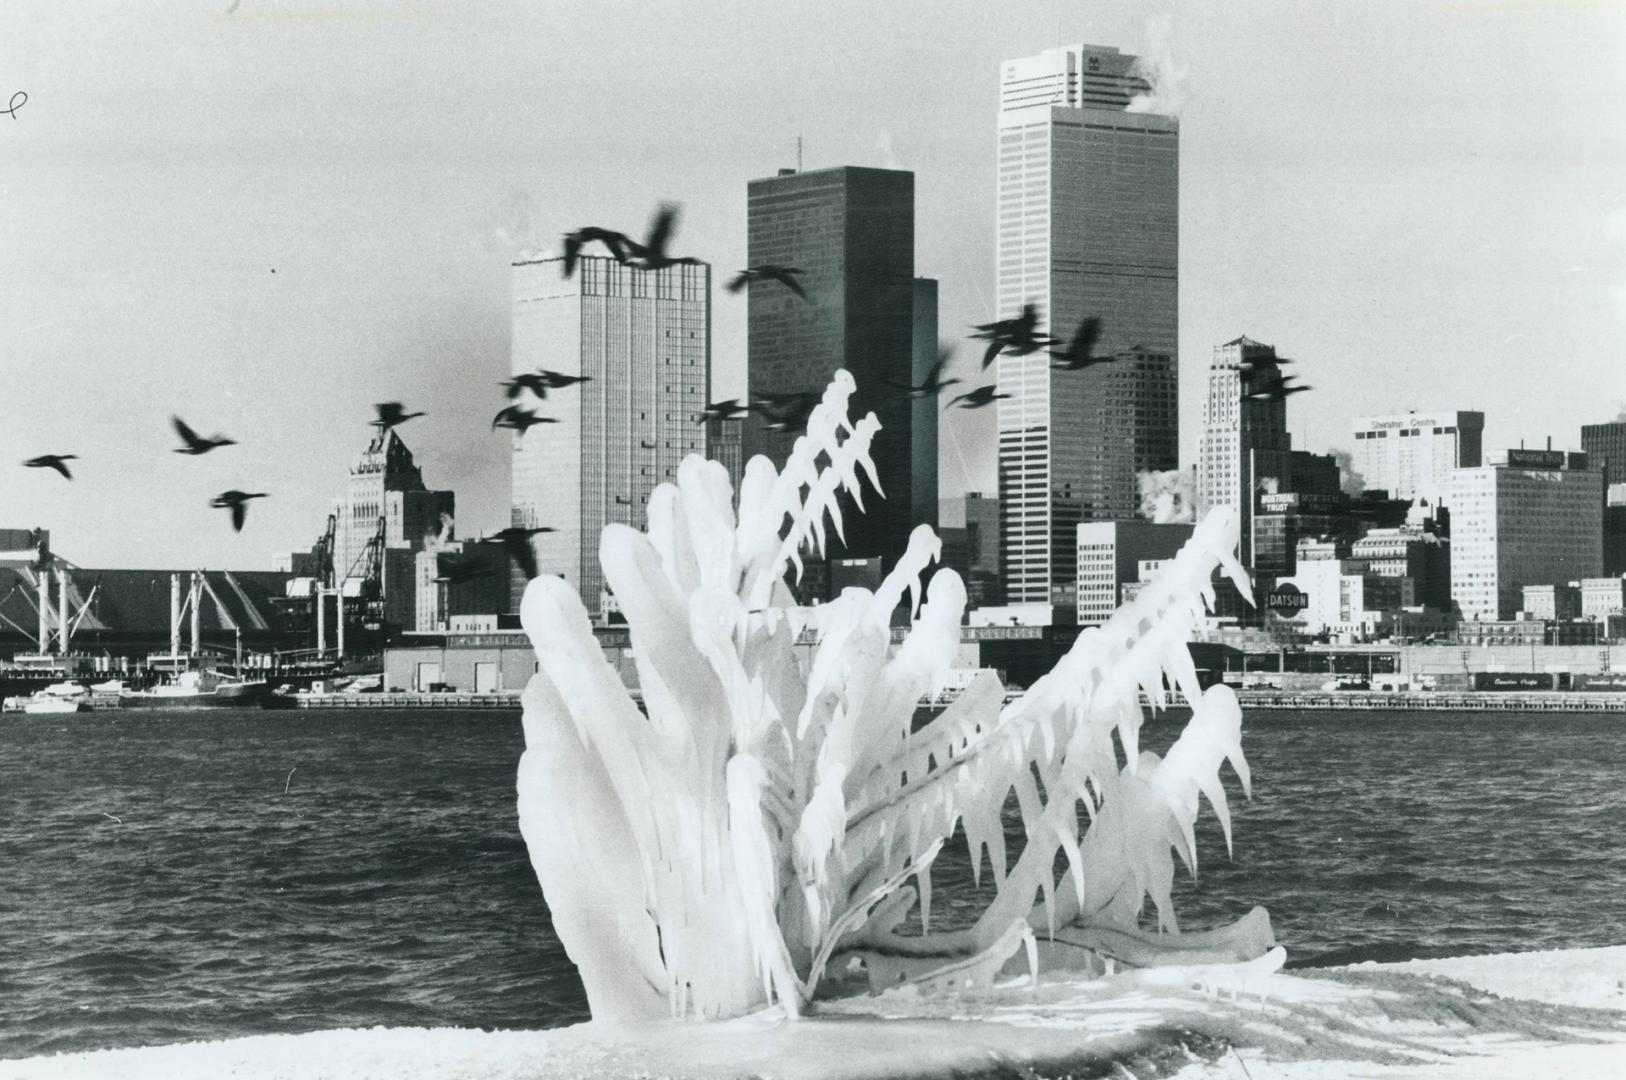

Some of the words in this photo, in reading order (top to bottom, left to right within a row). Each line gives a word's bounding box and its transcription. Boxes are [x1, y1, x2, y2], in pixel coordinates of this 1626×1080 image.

[1261, 493, 1295, 504] MONTREAL
[1267, 503, 1288, 512] TRUST
[1270, 595, 1306, 606] DATSUN
